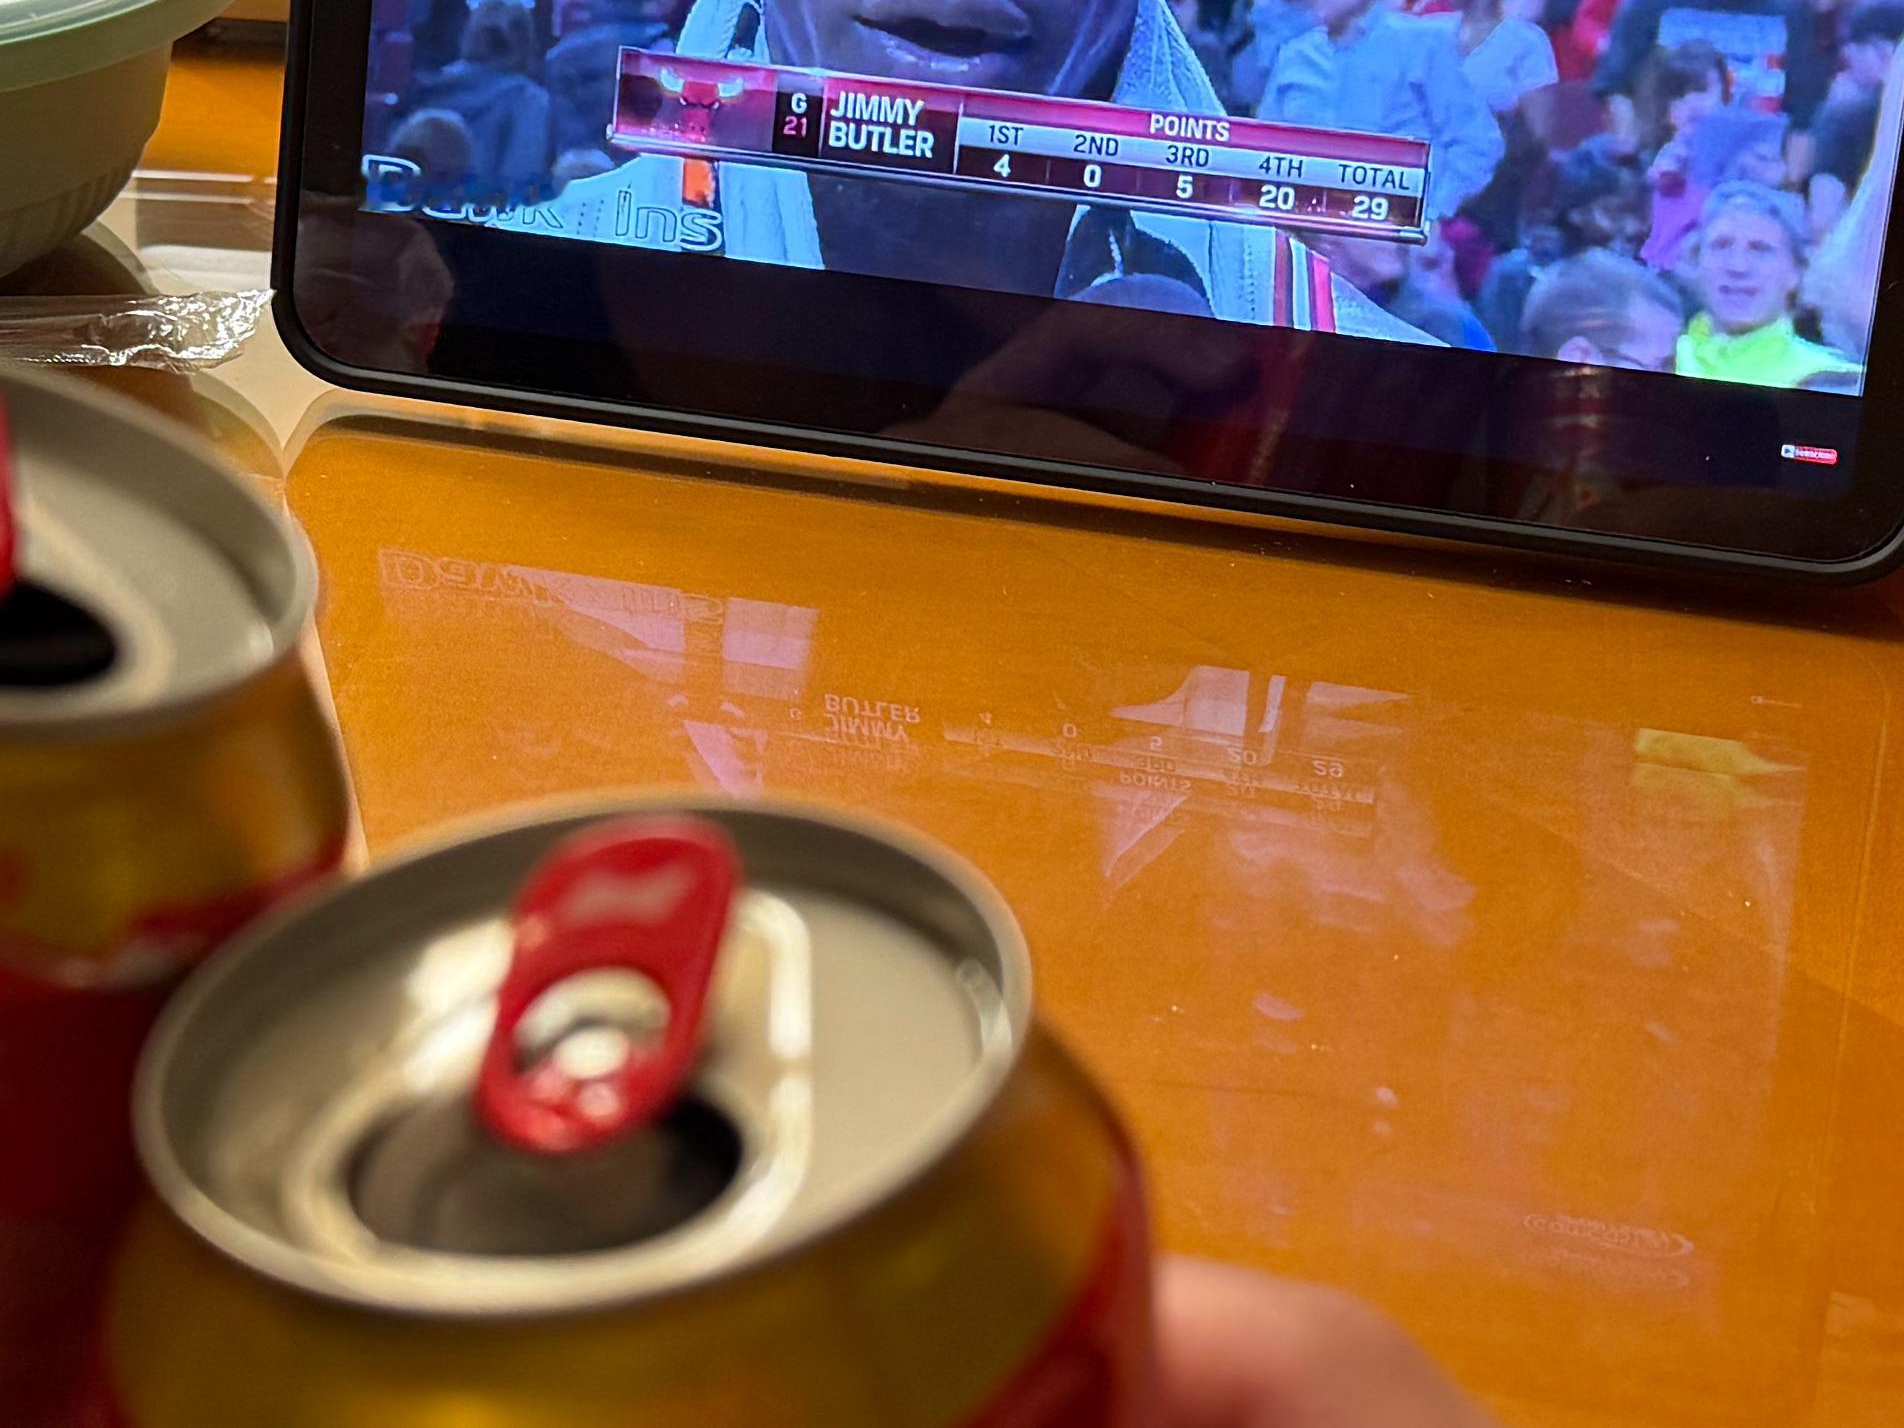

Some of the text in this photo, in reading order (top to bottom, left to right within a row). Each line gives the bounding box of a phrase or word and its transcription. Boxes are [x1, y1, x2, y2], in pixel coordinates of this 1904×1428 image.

[791, 93, 808, 114] G
[829, 91, 925, 126] JIMMY
[783, 116, 807, 137] 21
[827, 121, 936, 159] BUTLER
[1149, 113, 1231, 142] POINTS
[987, 125, 1411, 191] 1ST 2ND 3RD 4TH TOTAL
[993, 153, 1389, 221] 4 0 5 20 29
